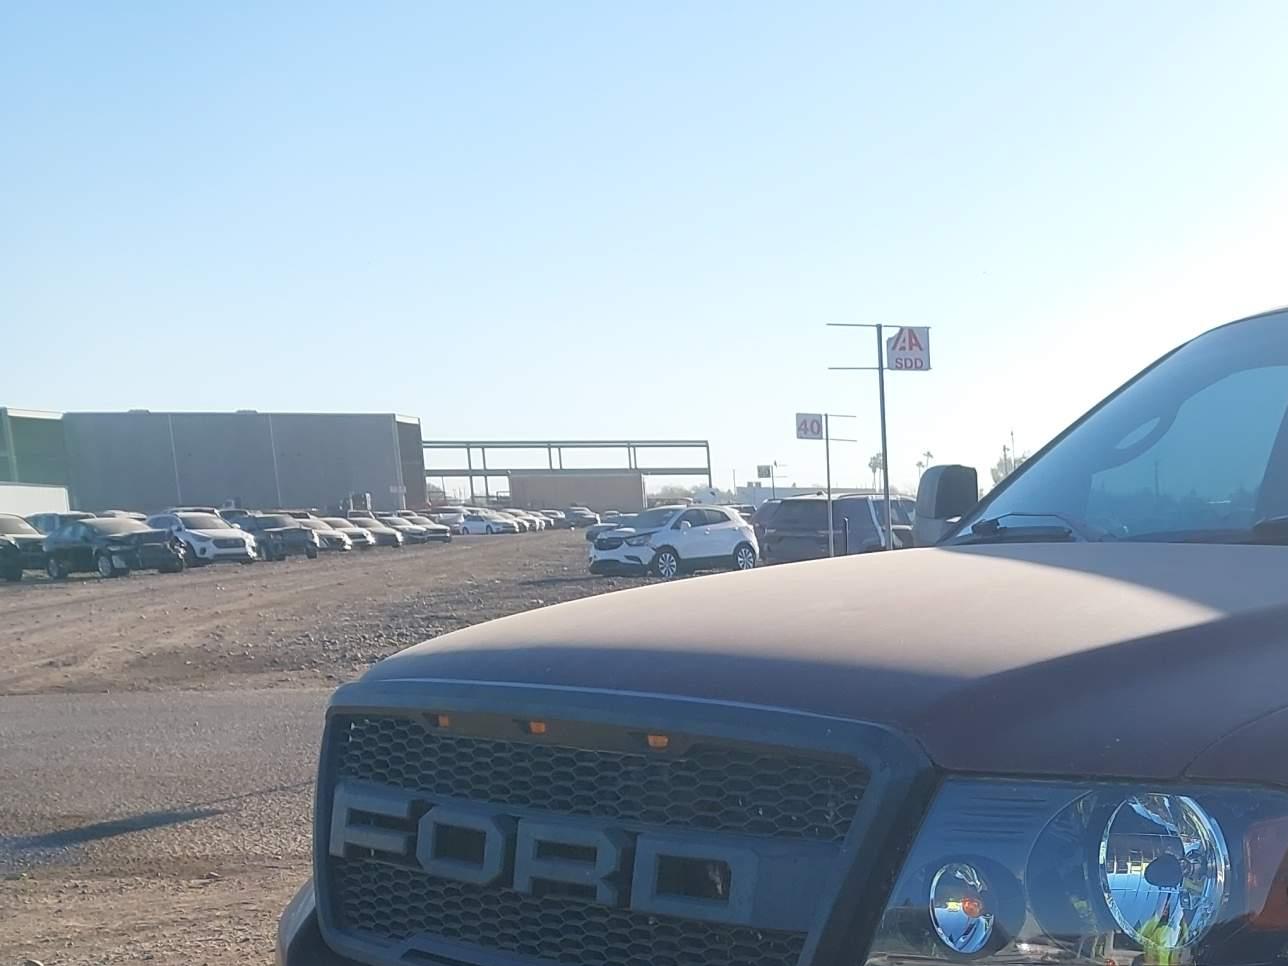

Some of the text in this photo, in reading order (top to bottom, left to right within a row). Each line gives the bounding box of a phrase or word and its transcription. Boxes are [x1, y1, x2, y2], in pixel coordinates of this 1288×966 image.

[896, 358, 924, 369] SDD
[798, 419, 822, 435] 40
[329, 782, 759, 923] FORD
